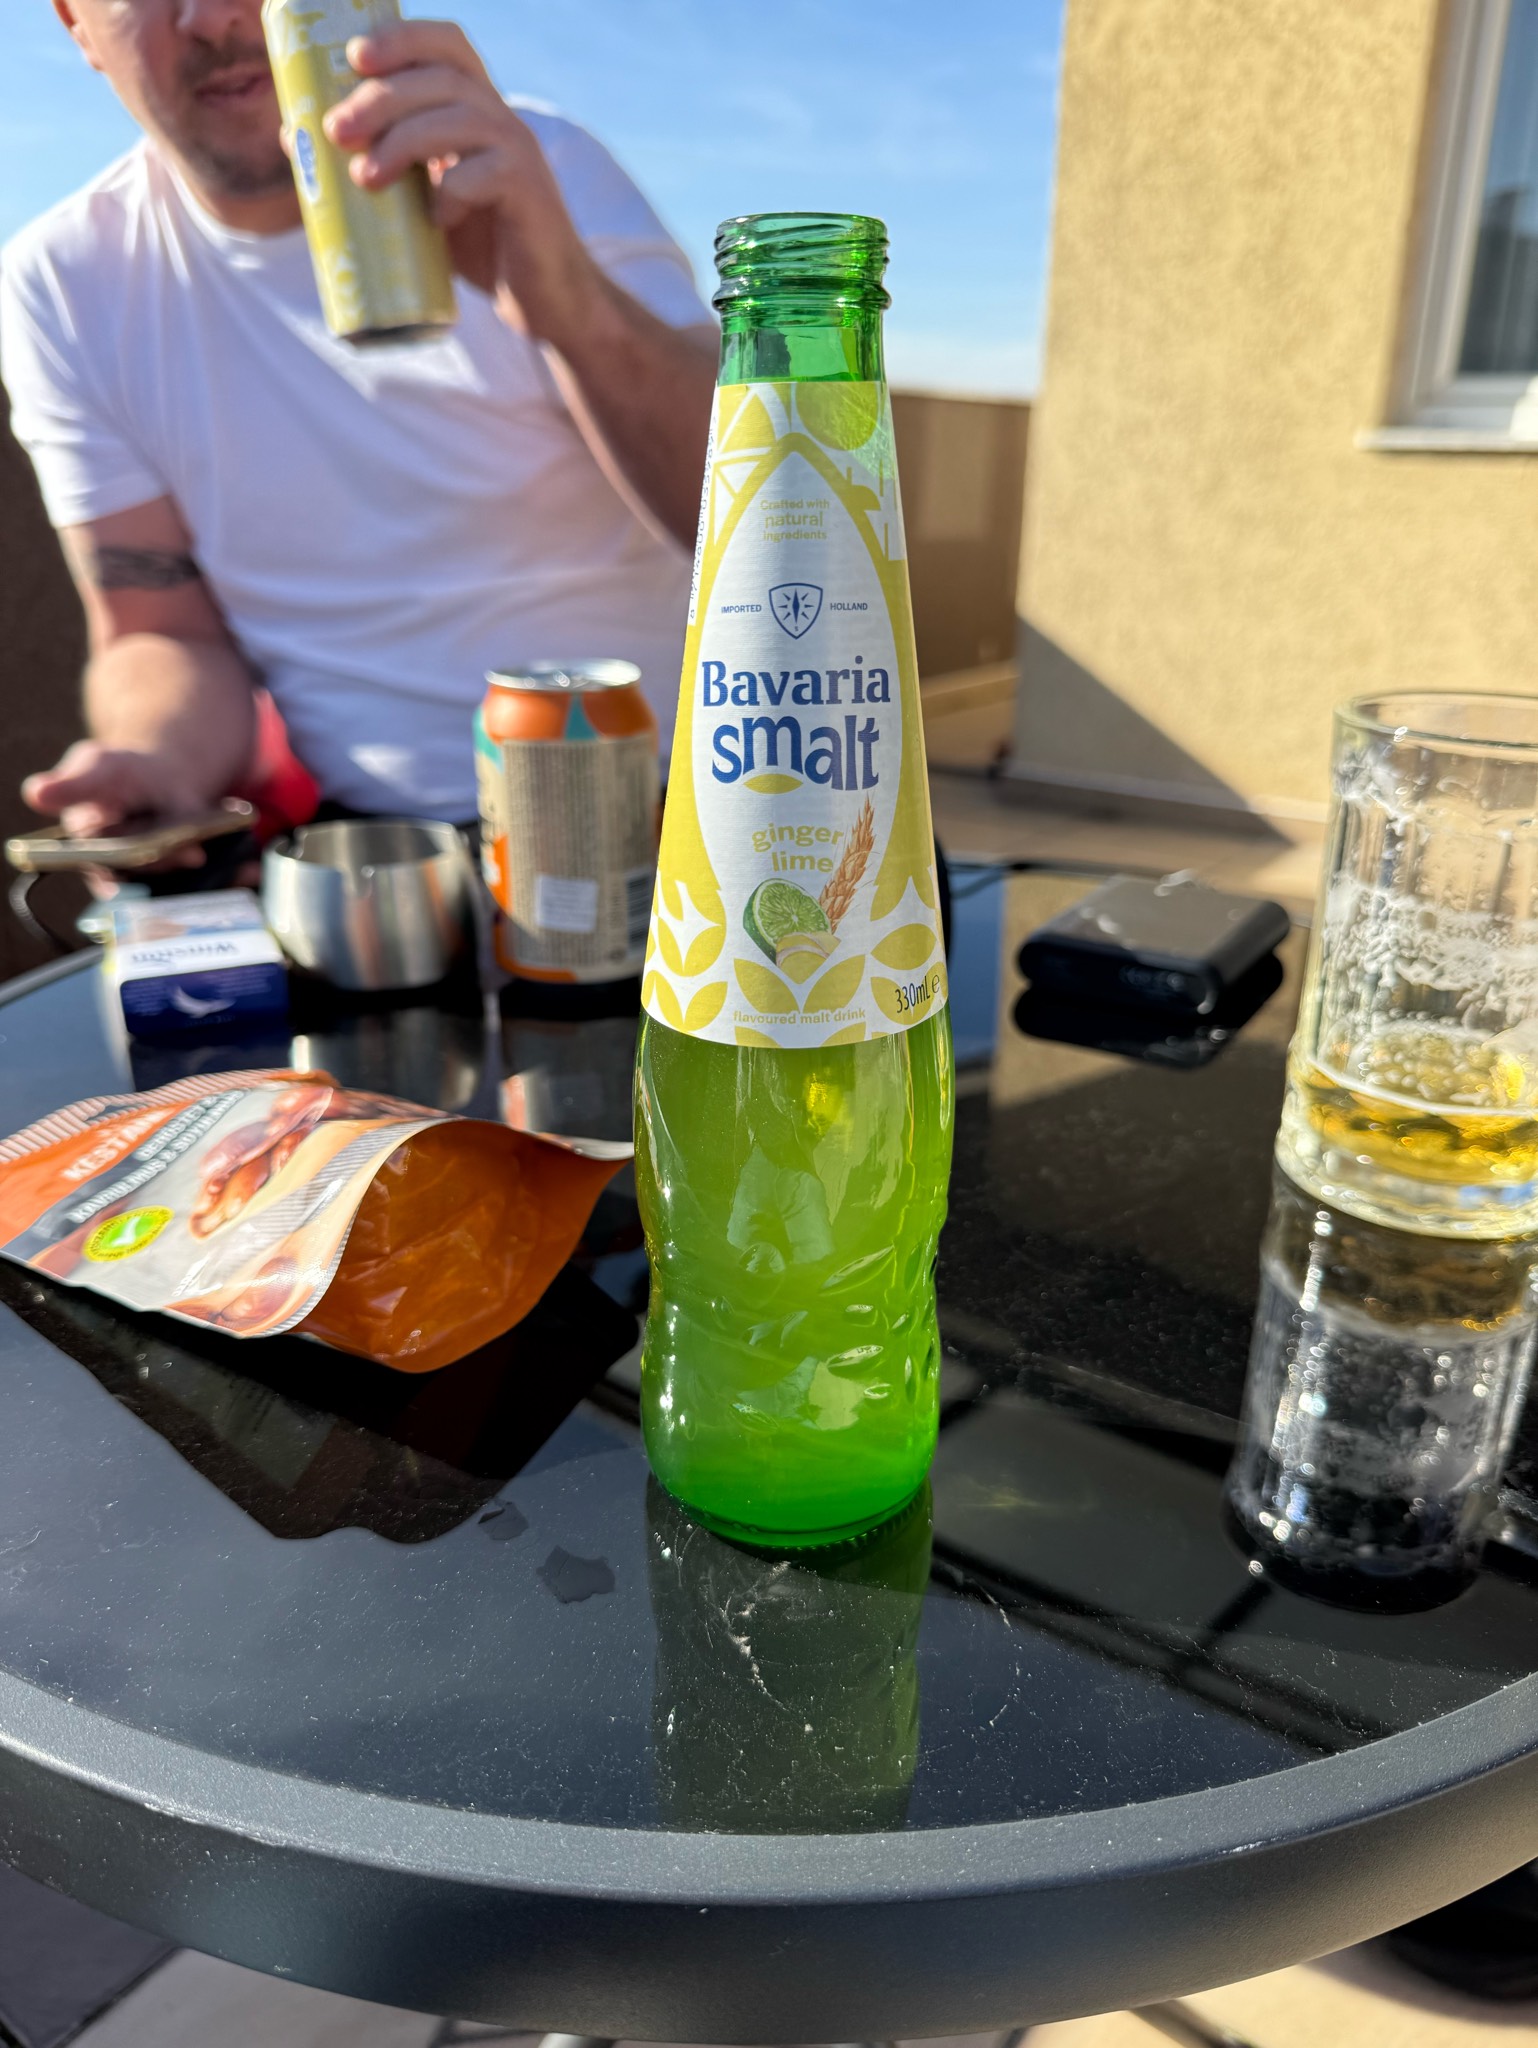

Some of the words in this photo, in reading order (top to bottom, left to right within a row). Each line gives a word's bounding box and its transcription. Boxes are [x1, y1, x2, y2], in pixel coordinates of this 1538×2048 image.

[761, 499, 803, 511] Crafted
[806, 498, 831, 509] with
[764, 511, 824, 529] natural
[763, 529, 827, 543] ingredients
[721, 604, 762, 614] IMPORTED
[830, 602, 868, 611] HOLLAND
[702, 655, 891, 706] Bavaria
[712, 715, 880, 791] smalt
[752, 823, 843, 851] ginger
[771, 851, 834, 873] lime
[894, 975, 931, 1013] 330mL
[733, 1010, 797, 1025] flavoured
[800, 1011, 831, 1024] malt
[833, 1008, 866, 1022] drink
